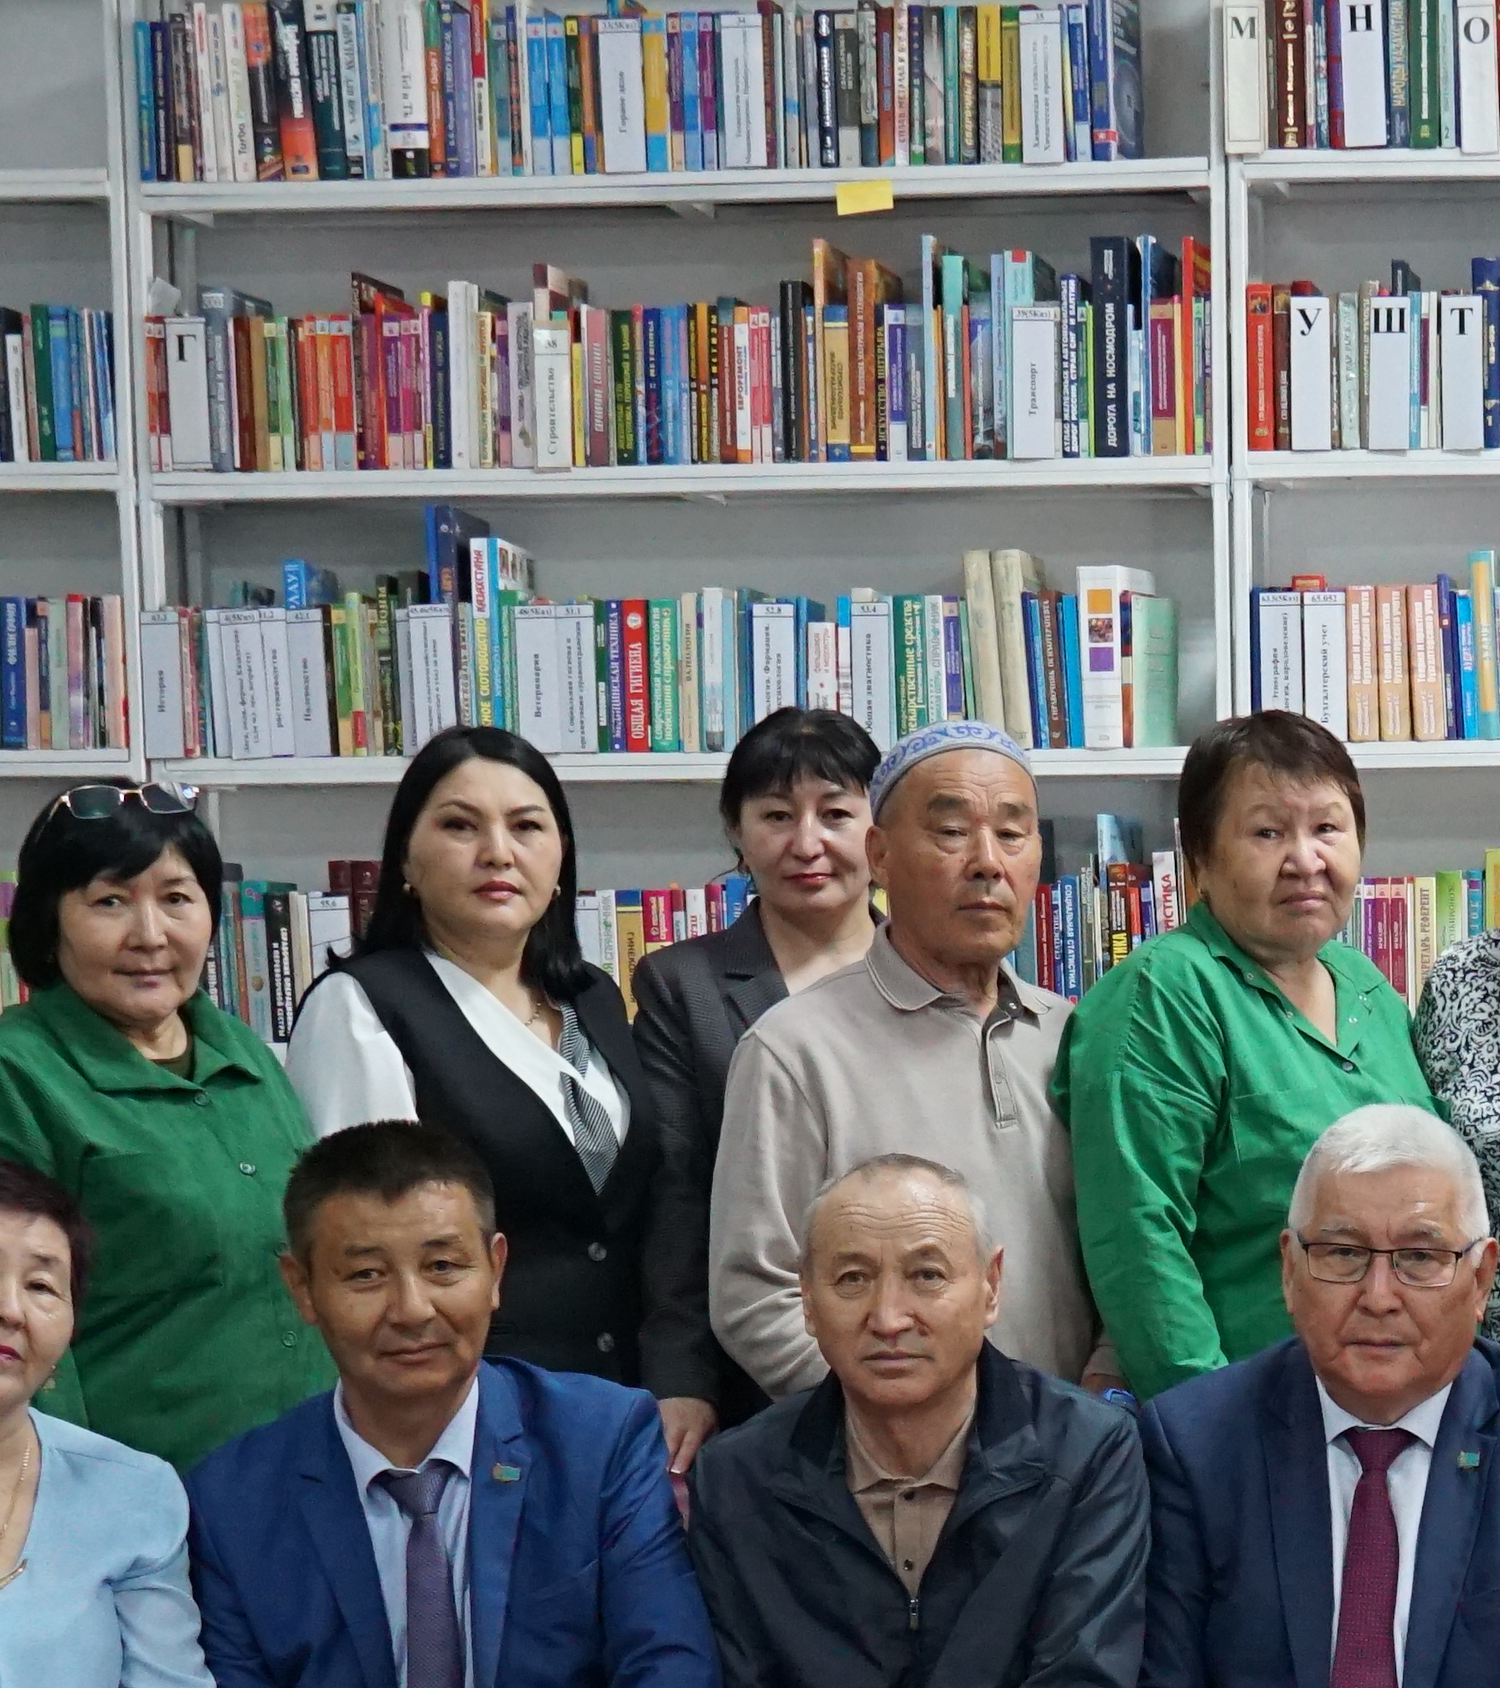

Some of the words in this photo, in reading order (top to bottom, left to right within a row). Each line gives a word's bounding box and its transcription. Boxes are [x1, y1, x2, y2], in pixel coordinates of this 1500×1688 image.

[1229, 16, 1258, 40] М
[1347, 4, 1374, 33] Н
[1391, 1, 1405, 62] КАЗАХСТАНА
[1463, 16, 1490, 45] О
[617, 72, 625, 96] дело
[1393, 65, 1406, 106] НАРОДЫ
[618, 99, 628, 134] Горное
[1061, 279, 1069, 359] АВТОМОБИЛЬНЫХ
[1296, 307, 1321, 336] У
[1371, 307, 1407, 334] Ш
[1450, 308, 1474, 335] Т
[176, 333, 197, 363] Г
[876, 326, 885, 378] ИНТЕРЬЕРА
[735, 345, 745, 410] ЕВРОРЕМОНТ
[1028, 363, 1038, 416] Транспорт
[1106, 383, 1117, 398] НА
[546, 367, 558, 455] Строительство
[877, 385, 886, 441] ИСКУССТВО
[1106, 404, 1118, 447] ДОРОГА
[472, 549, 487, 613] КАЗАХСТАНА
[1362, 591, 1371, 615] учета
[1393, 590, 1401, 614] учета
[1425, 590, 1434, 614] учета
[609, 611, 619, 661] ТЕХНИКА
[902, 600, 916, 645] средства
[930, 601, 941, 667] СПРАВОЧНИК
[1321, 623, 1329, 646] учет
[1351, 604, 1360, 646] практика
[1382, 603, 1391, 645] практика
[1415, 602, 1423, 645] практика
[476, 619, 491, 697] СКОТОВОДСТВО
[628, 642, 644, 693] ГИГИЕНА
[864, 634, 873, 696] диагностика
[1351, 656, 1361, 685] Теория
[1362, 619, 1372, 684] бухгалтерского
[1382, 655, 1391, 684] Теория
[1392, 618, 1403, 683] бухгалтерского
[1415, 655, 1424, 683] Теория
[1425, 617, 1436, 683] бухгалтерского
[532, 653, 543, 717] Ветеринария
[611, 663, 621, 738] МЕДИЦИНСКАЯ
[1048, 671, 1059, 720] СПРАВОЧНИК
[1319, 650, 1331, 723] Бухгалтерский
[629, 699, 645, 739] ОБЩАЯ
[864, 700, 875, 734] Общая
[603, 895, 613, 960] СПРАВОЧНИК
[1065, 884, 1075, 937] СОЦИАЛЬНАЯ
[1066, 940, 1076, 990] СТАТИСТИКА
